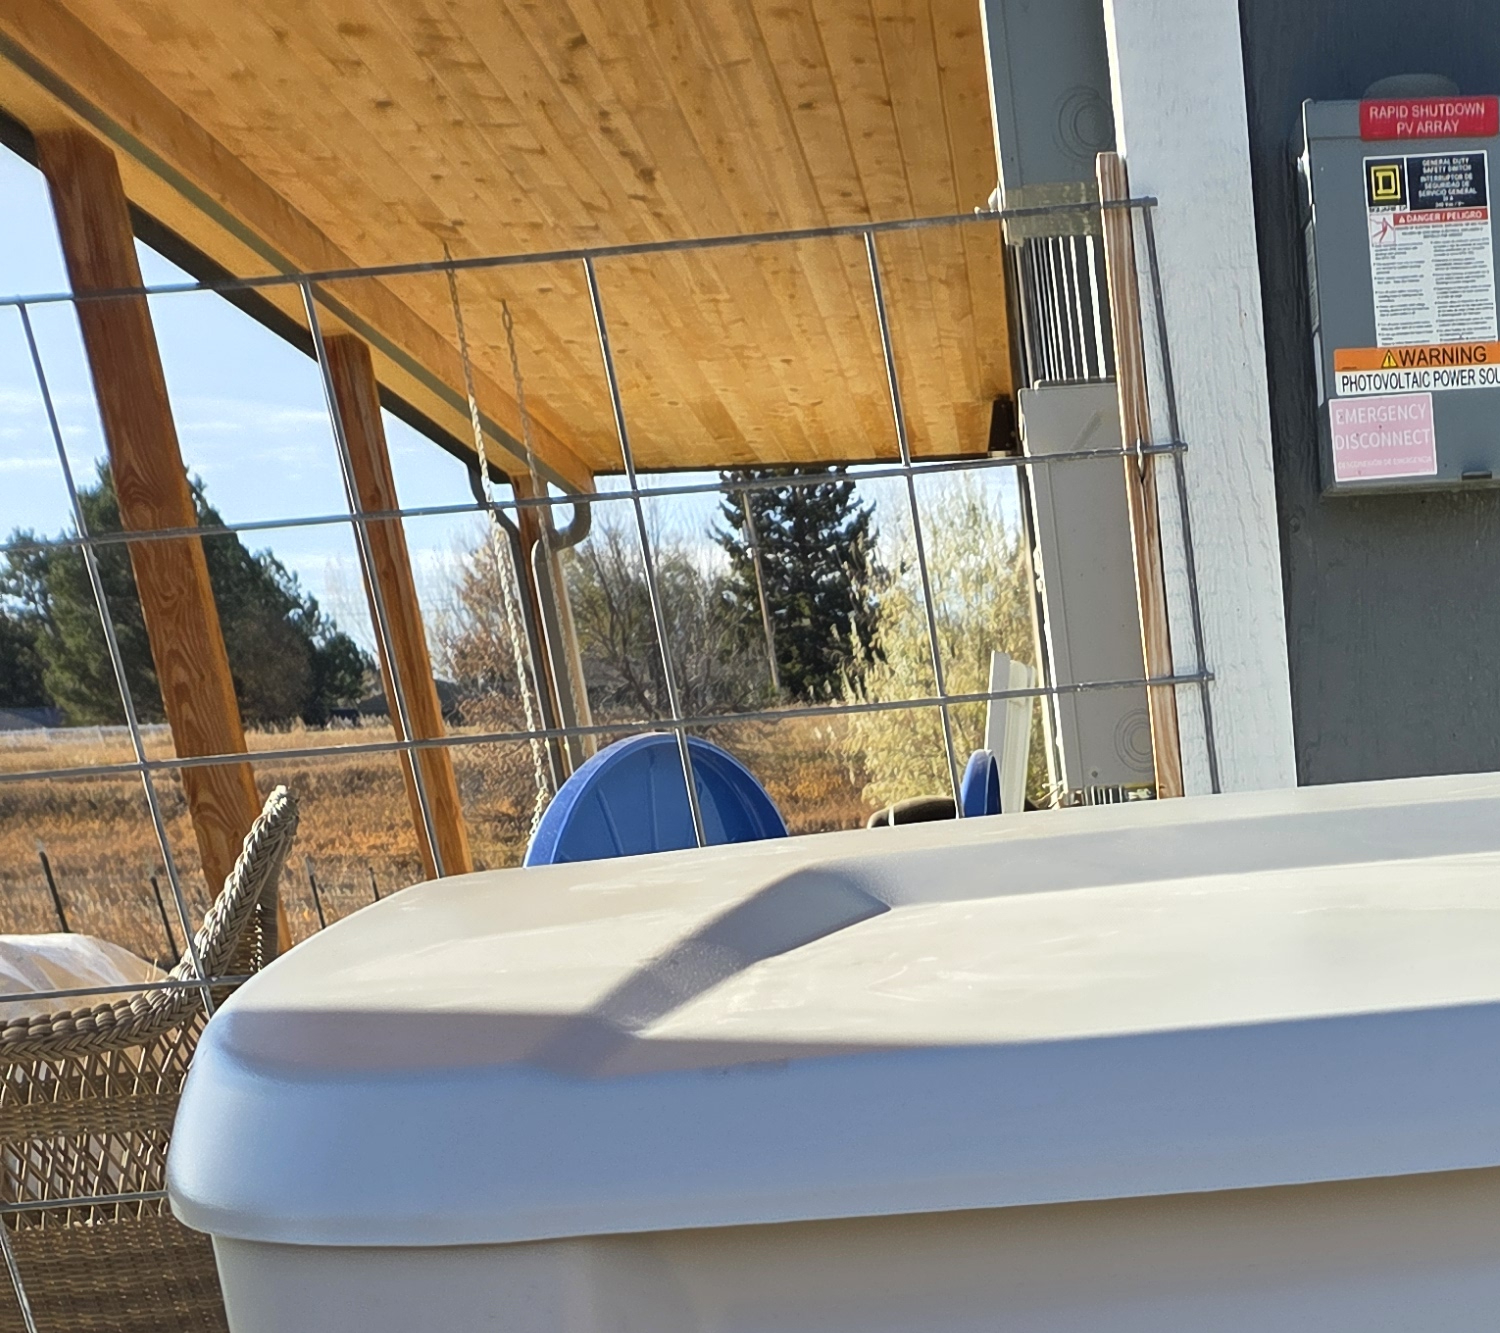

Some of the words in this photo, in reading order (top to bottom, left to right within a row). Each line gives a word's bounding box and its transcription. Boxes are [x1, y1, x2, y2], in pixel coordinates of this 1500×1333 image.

[1369, 104, 1408, 121] RAPID
[1411, 102, 1485, 119] SHUTDOWN
[1396, 121, 1414, 136] PV
[1416, 119, 1460, 134] ARRAY
[1406, 213, 1441, 224] DANGER
[1446, 211, 1483, 221] PELIGRO
[1398, 345, 1487, 367] WARNING
[1341, 371, 1431, 393] PHOTOVOLTAIC
[1433, 368, 1476, 388] POWER
[1335, 403, 1427, 425] EMERGENCY
[1334, 428, 1431, 451] DISCONNECT
